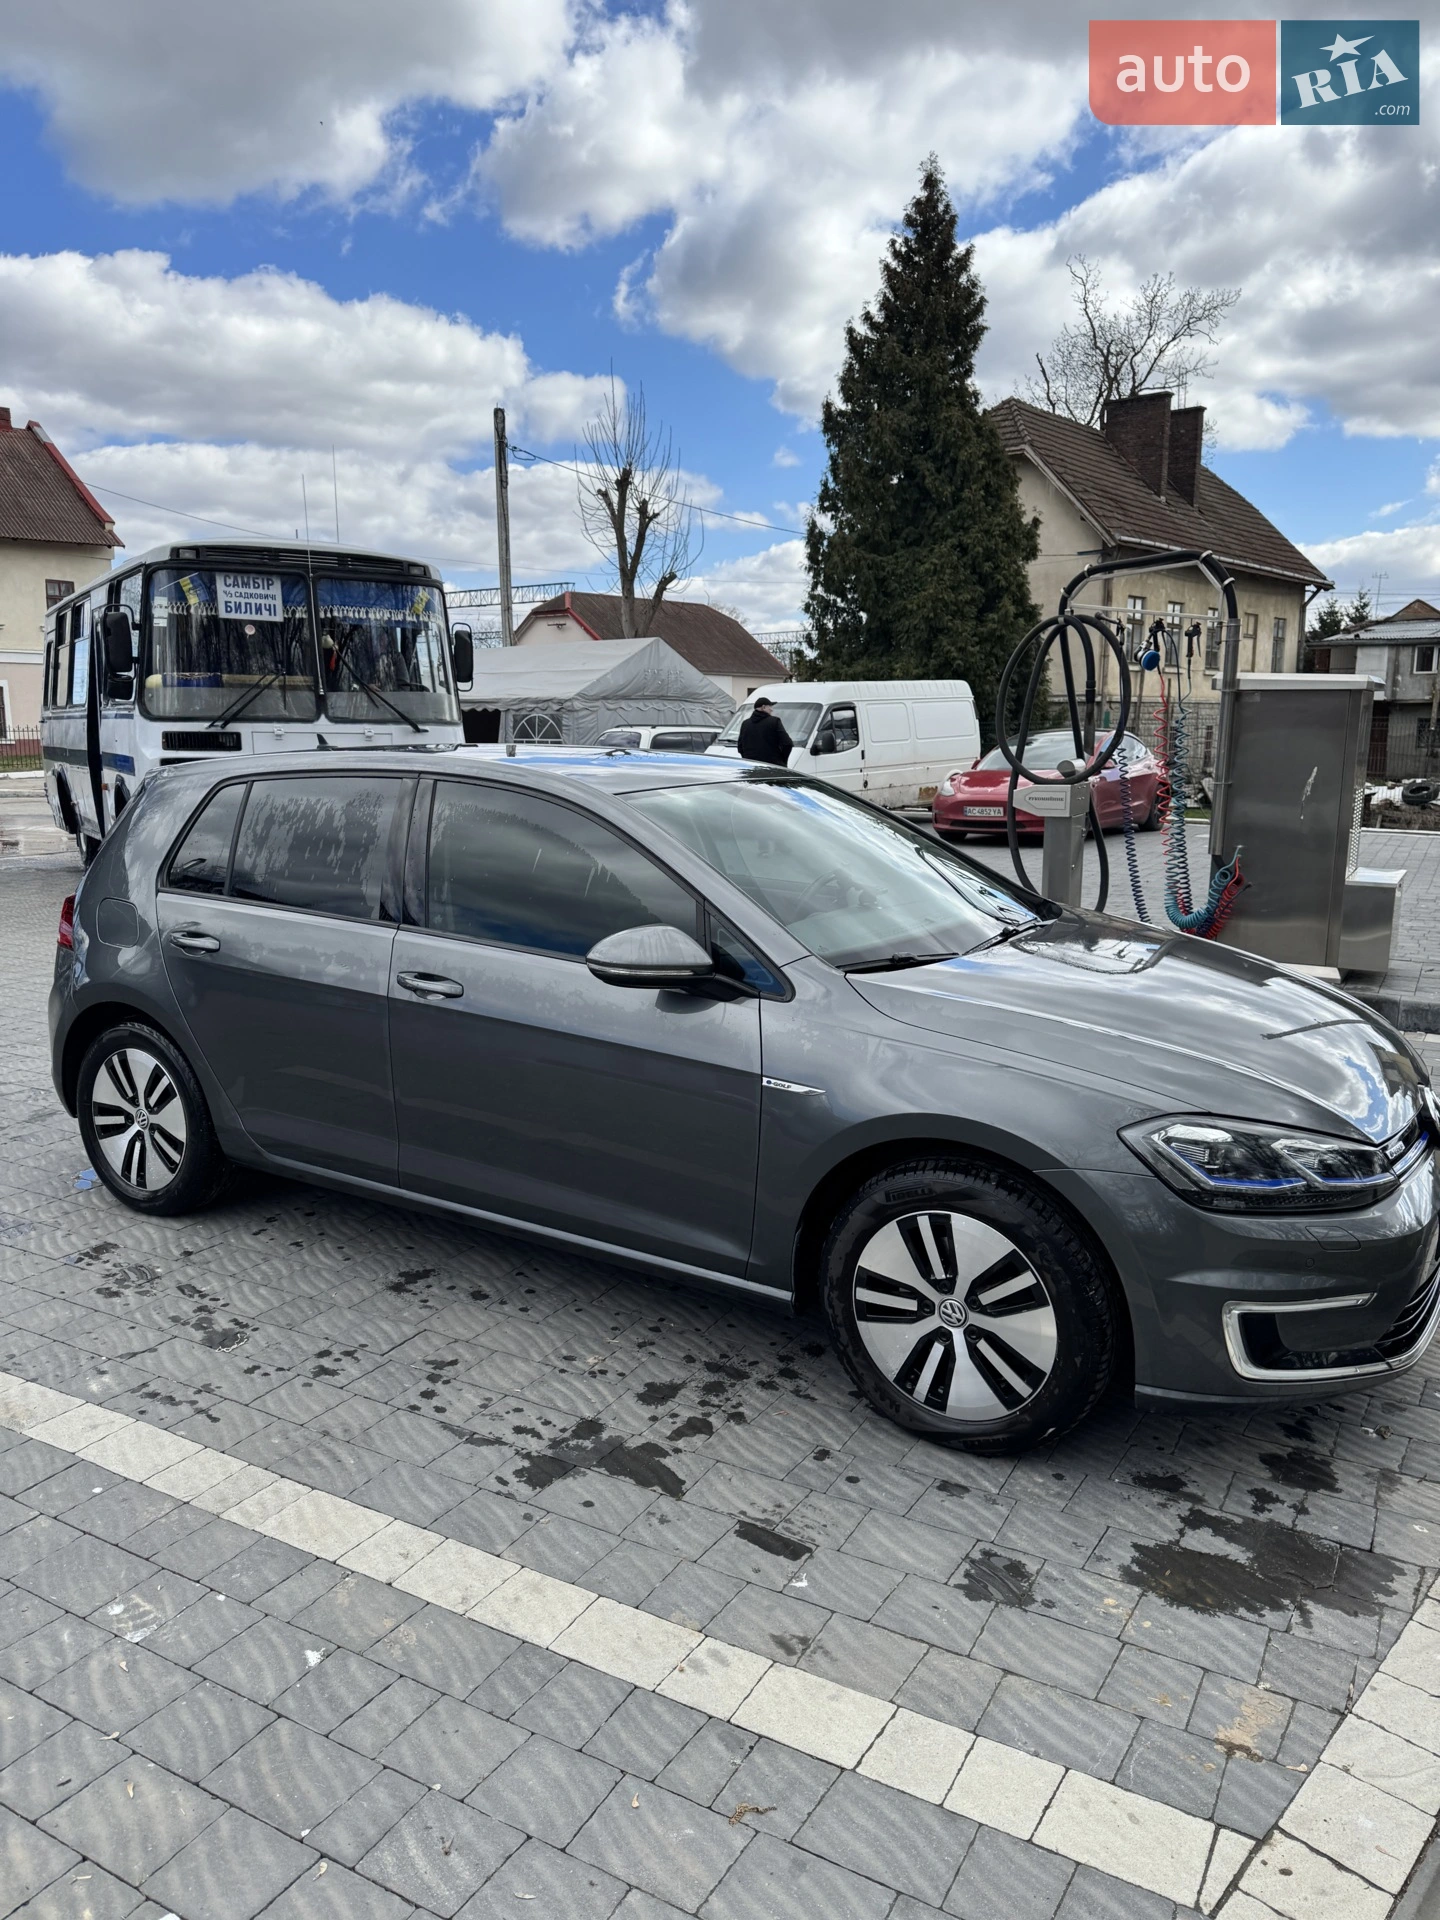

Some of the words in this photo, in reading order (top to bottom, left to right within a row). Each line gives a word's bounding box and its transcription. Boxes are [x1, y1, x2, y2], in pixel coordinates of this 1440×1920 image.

[223, 574, 275, 590] САМБІР
[234, 591, 277, 601] САДКОВИЧІ
[224, 600, 277, 617] БИЛИЧІ
